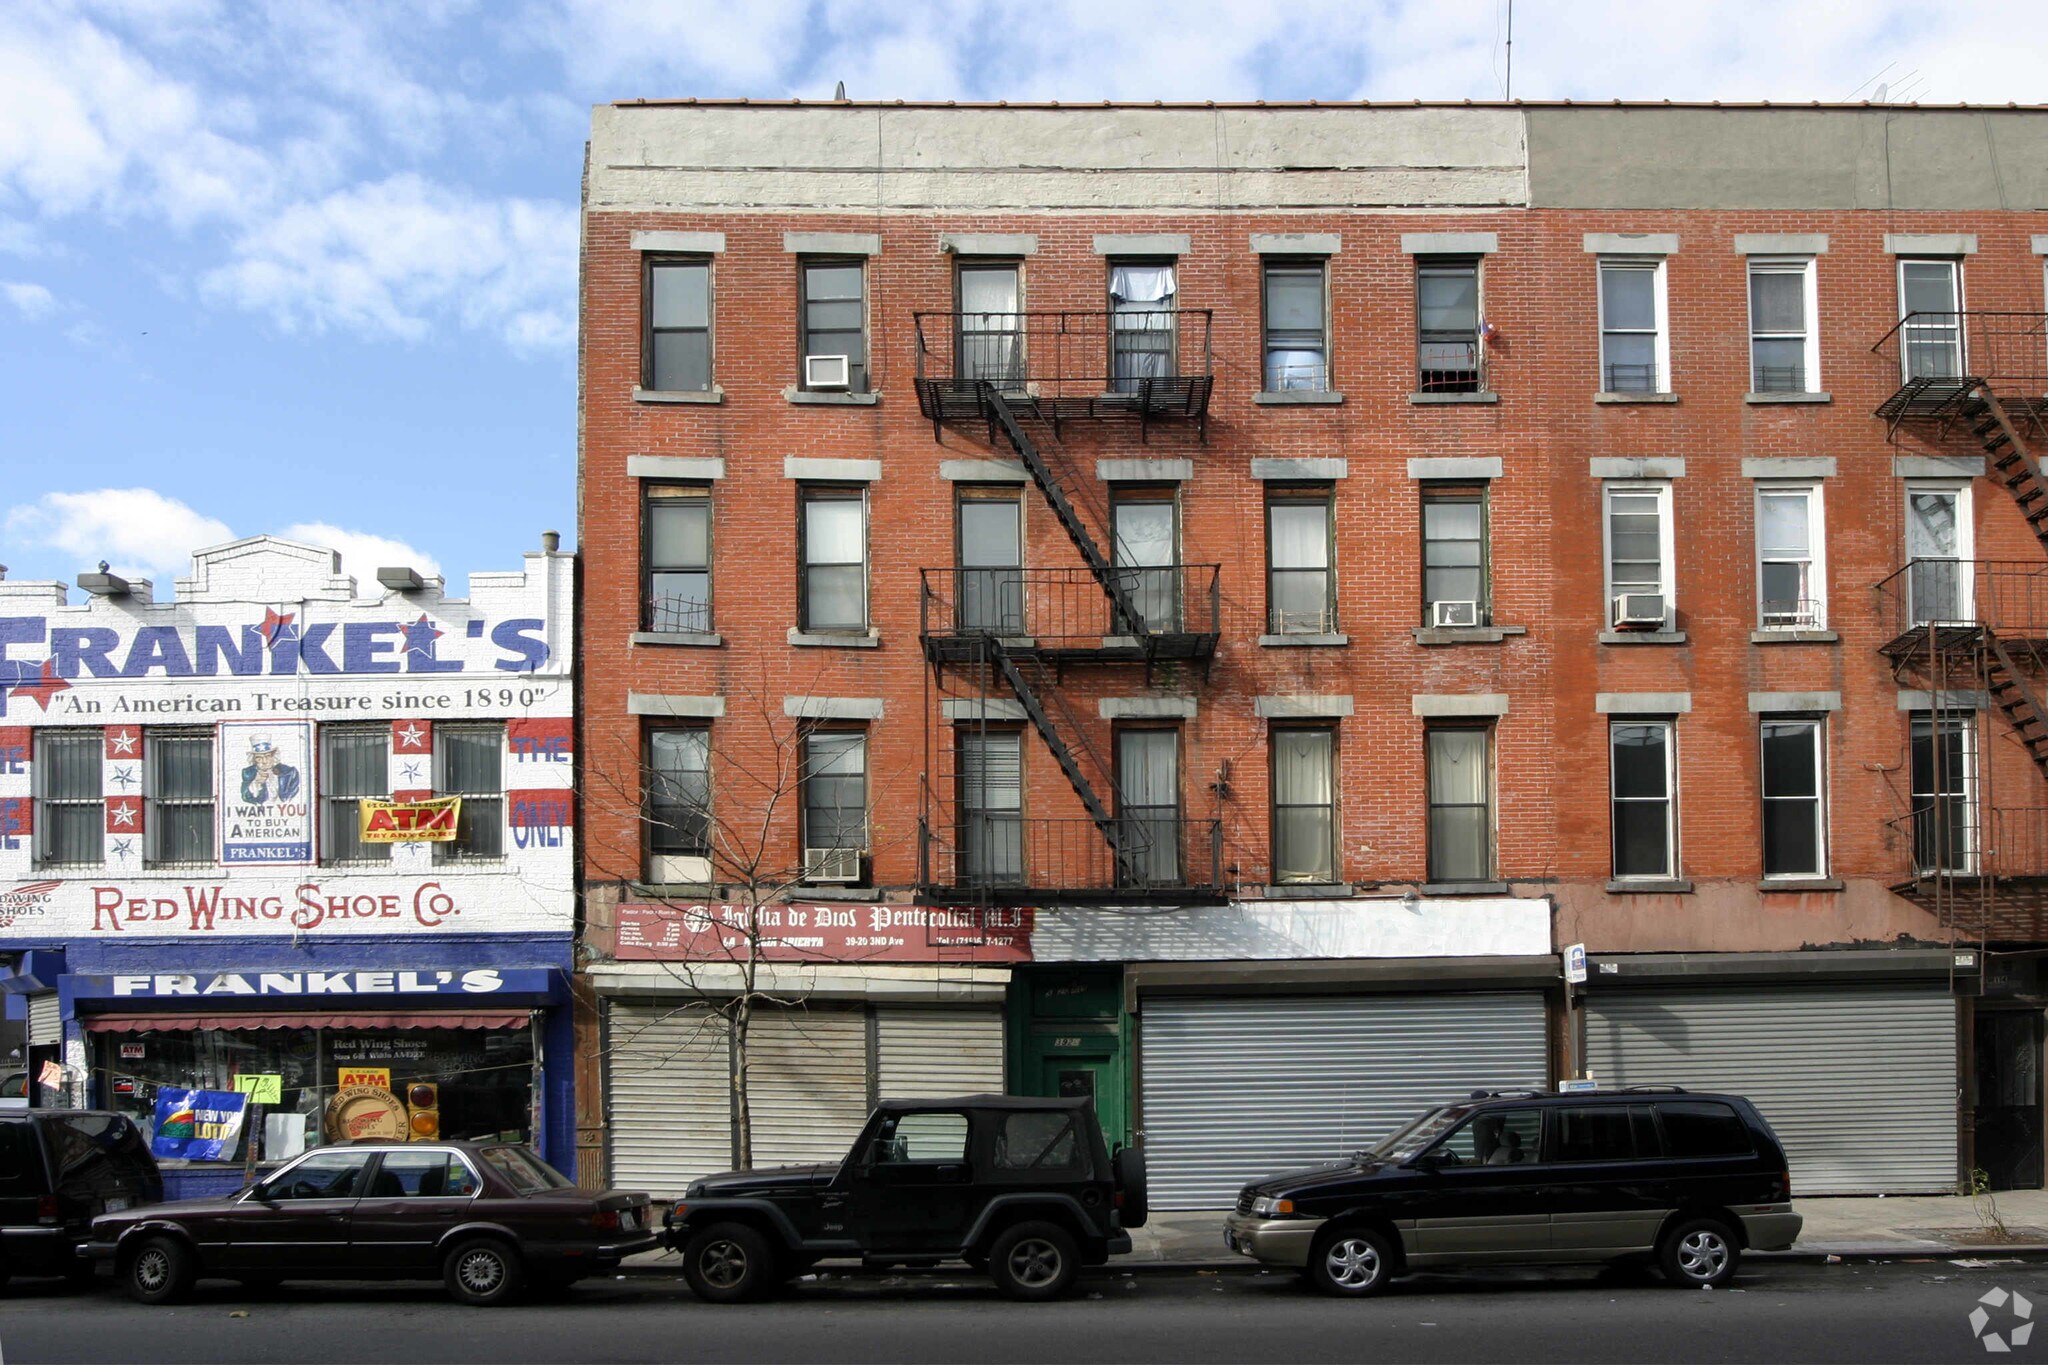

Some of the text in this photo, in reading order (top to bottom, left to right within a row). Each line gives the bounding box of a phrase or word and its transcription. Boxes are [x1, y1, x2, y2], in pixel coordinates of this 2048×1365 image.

[0, 616, 550, 718] FRANKEL'S
[55, 695, 100, 713] "An
[112, 693, 242, 713] American
[251, 692, 372, 712] Treasure
[382, 691, 451, 709] since
[512, 736, 569, 763] THE
[227, 803, 307, 818] I WANT YOU
[247, 819, 288, 827] TO BUY
[367, 808, 456, 831] ATM
[513, 800, 568, 850] ONLY
[230, 823, 300, 838] AMERICAN
[230, 847, 306, 859] FRANKEL'S
[12, 894, 52, 903] WING
[0, 905, 45, 916] SHOES
[90, 886, 179, 931] RED
[183, 886, 284, 931] WING
[290, 883, 401, 930] SHOE
[720, 905, 782, 931] Iglsia
[788, 907, 808, 927] de
[814, 906, 857, 928] Dios
[868, 906, 976, 932] Pentecostal
[723, 936, 736, 947] LA
[845, 936, 905, 946] 39-20 3ND Ave
[113, 969, 503, 996] FRANKEL'S
[123, 1046, 143, 1054] ATM
[333, 1038, 428, 1050] Red Wing Shoes
[343, 1073, 387, 1087] ATM
[344, 1087, 370, 1098] WING
[372, 1088, 401, 1112] SHOES
[194, 1109, 219, 1122] NEW
